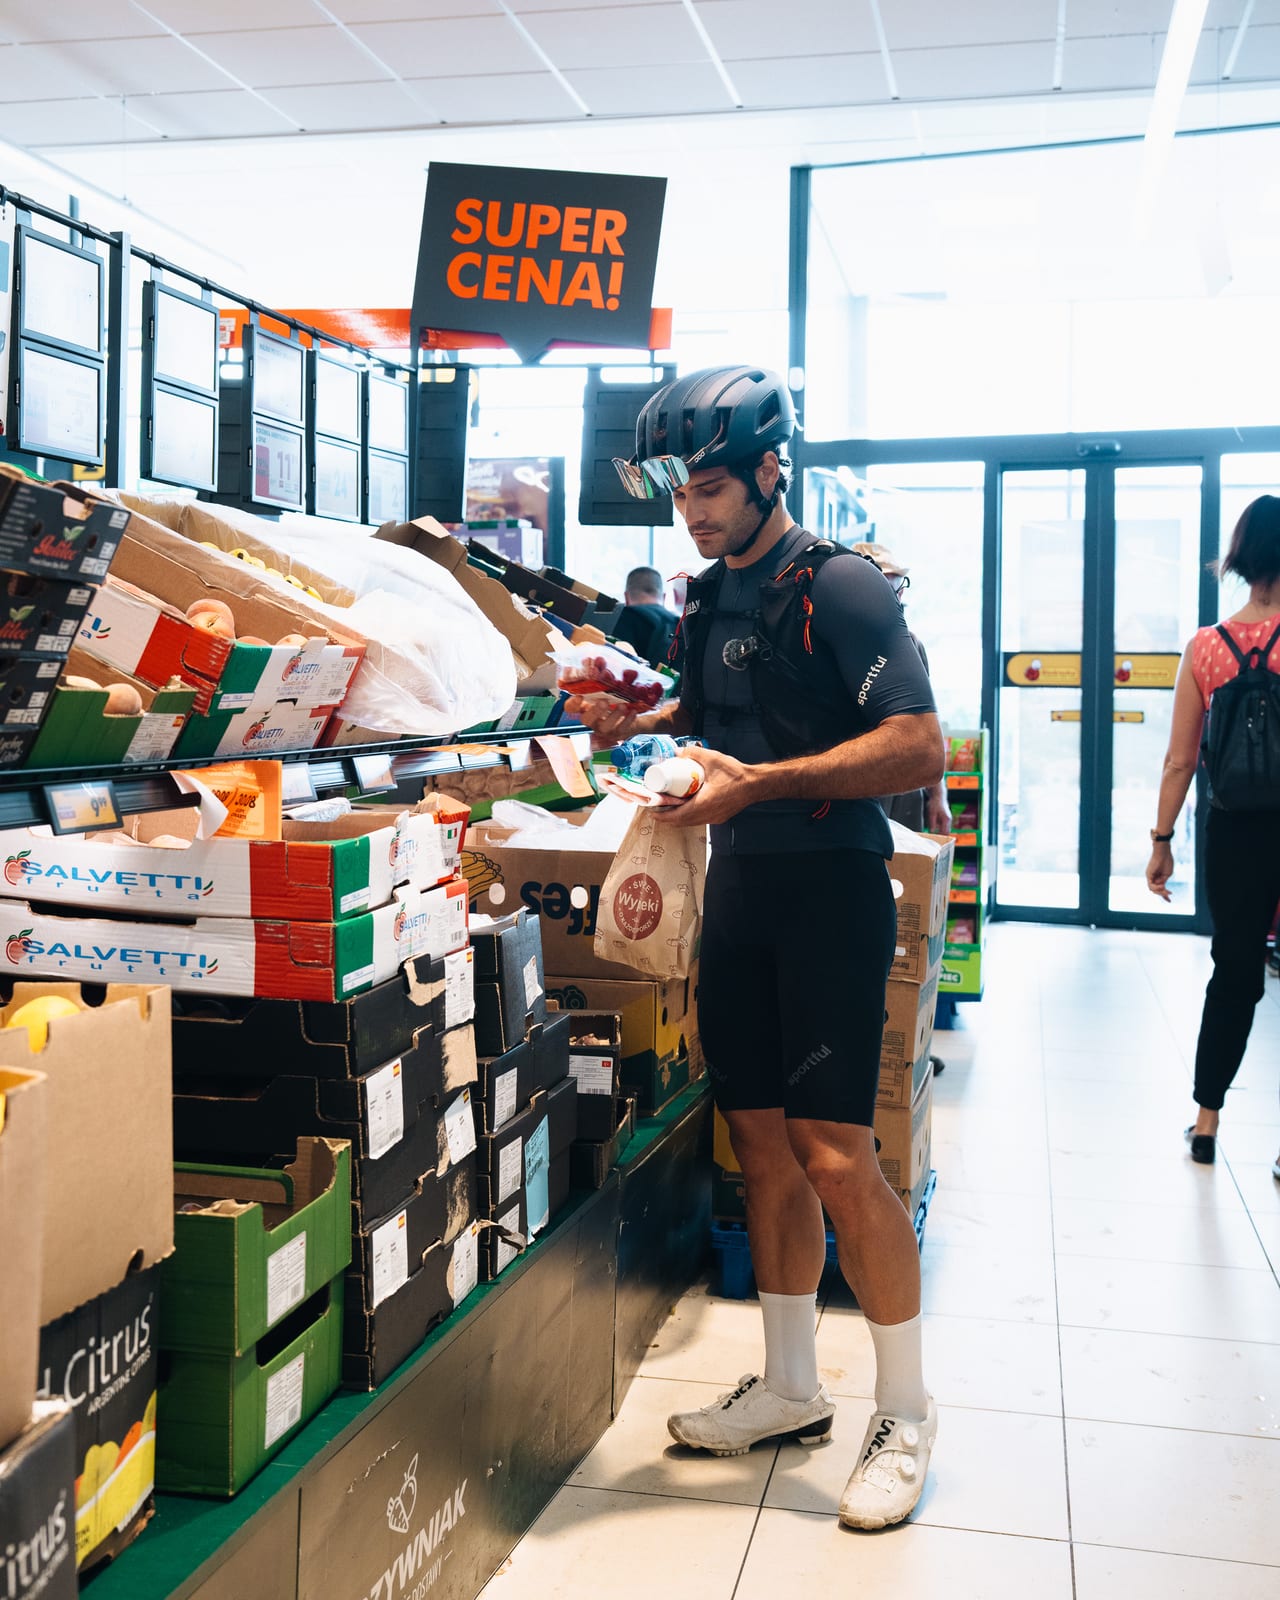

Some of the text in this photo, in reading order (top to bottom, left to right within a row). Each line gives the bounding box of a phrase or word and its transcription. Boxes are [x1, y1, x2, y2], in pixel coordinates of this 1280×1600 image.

[451, 197, 628, 256] SUPER
[446, 251, 625, 311] CENA!
[288, 663, 320, 674] SALVETTI
[857, 655, 888, 706] sportful
[250, 728, 284, 740] SALVETTI
[21, 861, 203, 890] SALVETTI
[26, 876, 200, 900] frutta
[399, 913, 428, 933] SALVETTI
[22, 940, 206, 969] SALVETTI
[28, 955, 204, 979] frutta
[787, 1043, 832, 1087] sportful
[64, 1305, 151, 1407] Citrus
[0, 1500, 67, 1599] itrus
